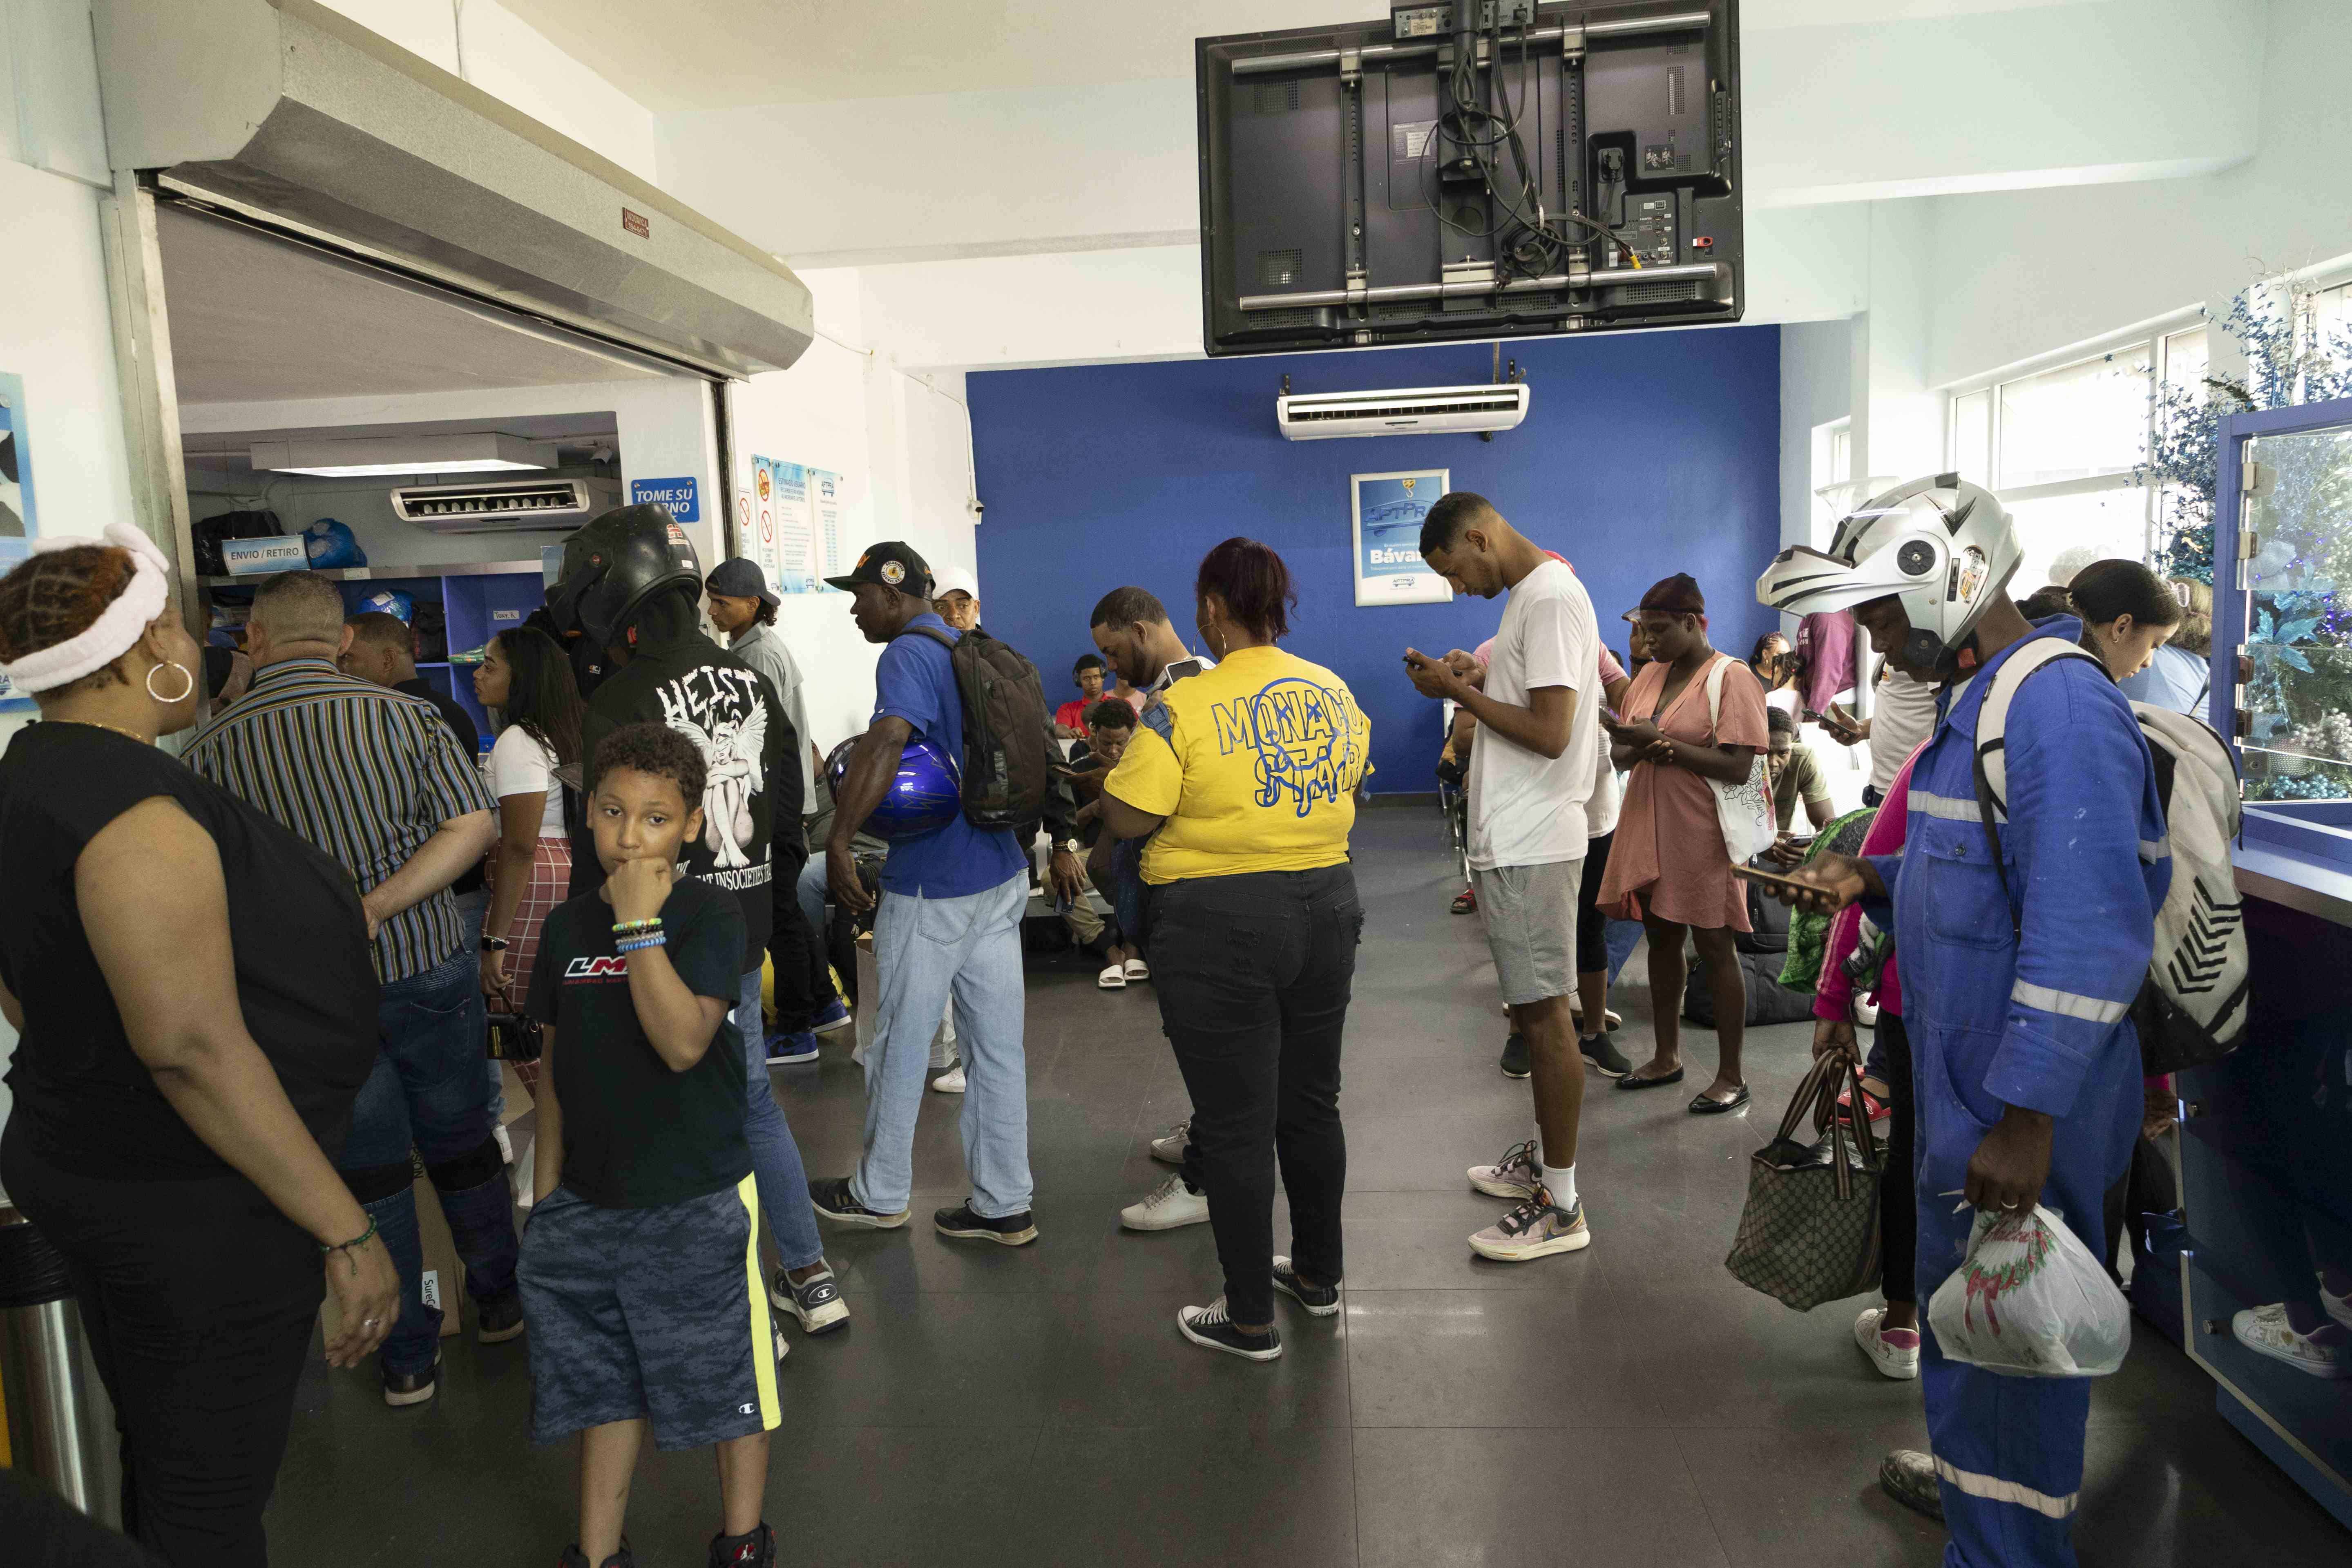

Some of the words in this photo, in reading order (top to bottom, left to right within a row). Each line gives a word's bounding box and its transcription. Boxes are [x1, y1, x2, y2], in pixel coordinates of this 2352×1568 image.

[636, 489, 673, 502] TOME
[675, 489, 693, 500] SU
[1369, 503, 1426, 521] APTPR
[231, 550, 259, 560] ENVIO
[261, 550, 265, 558] /
[266, 547, 299, 557] RETIRO
[1370, 548, 1422, 564] Bávar
[656, 666, 758, 728] HEIST
[1211, 688, 1363, 756] MONACO
[1254, 743, 1360, 808] STAR
